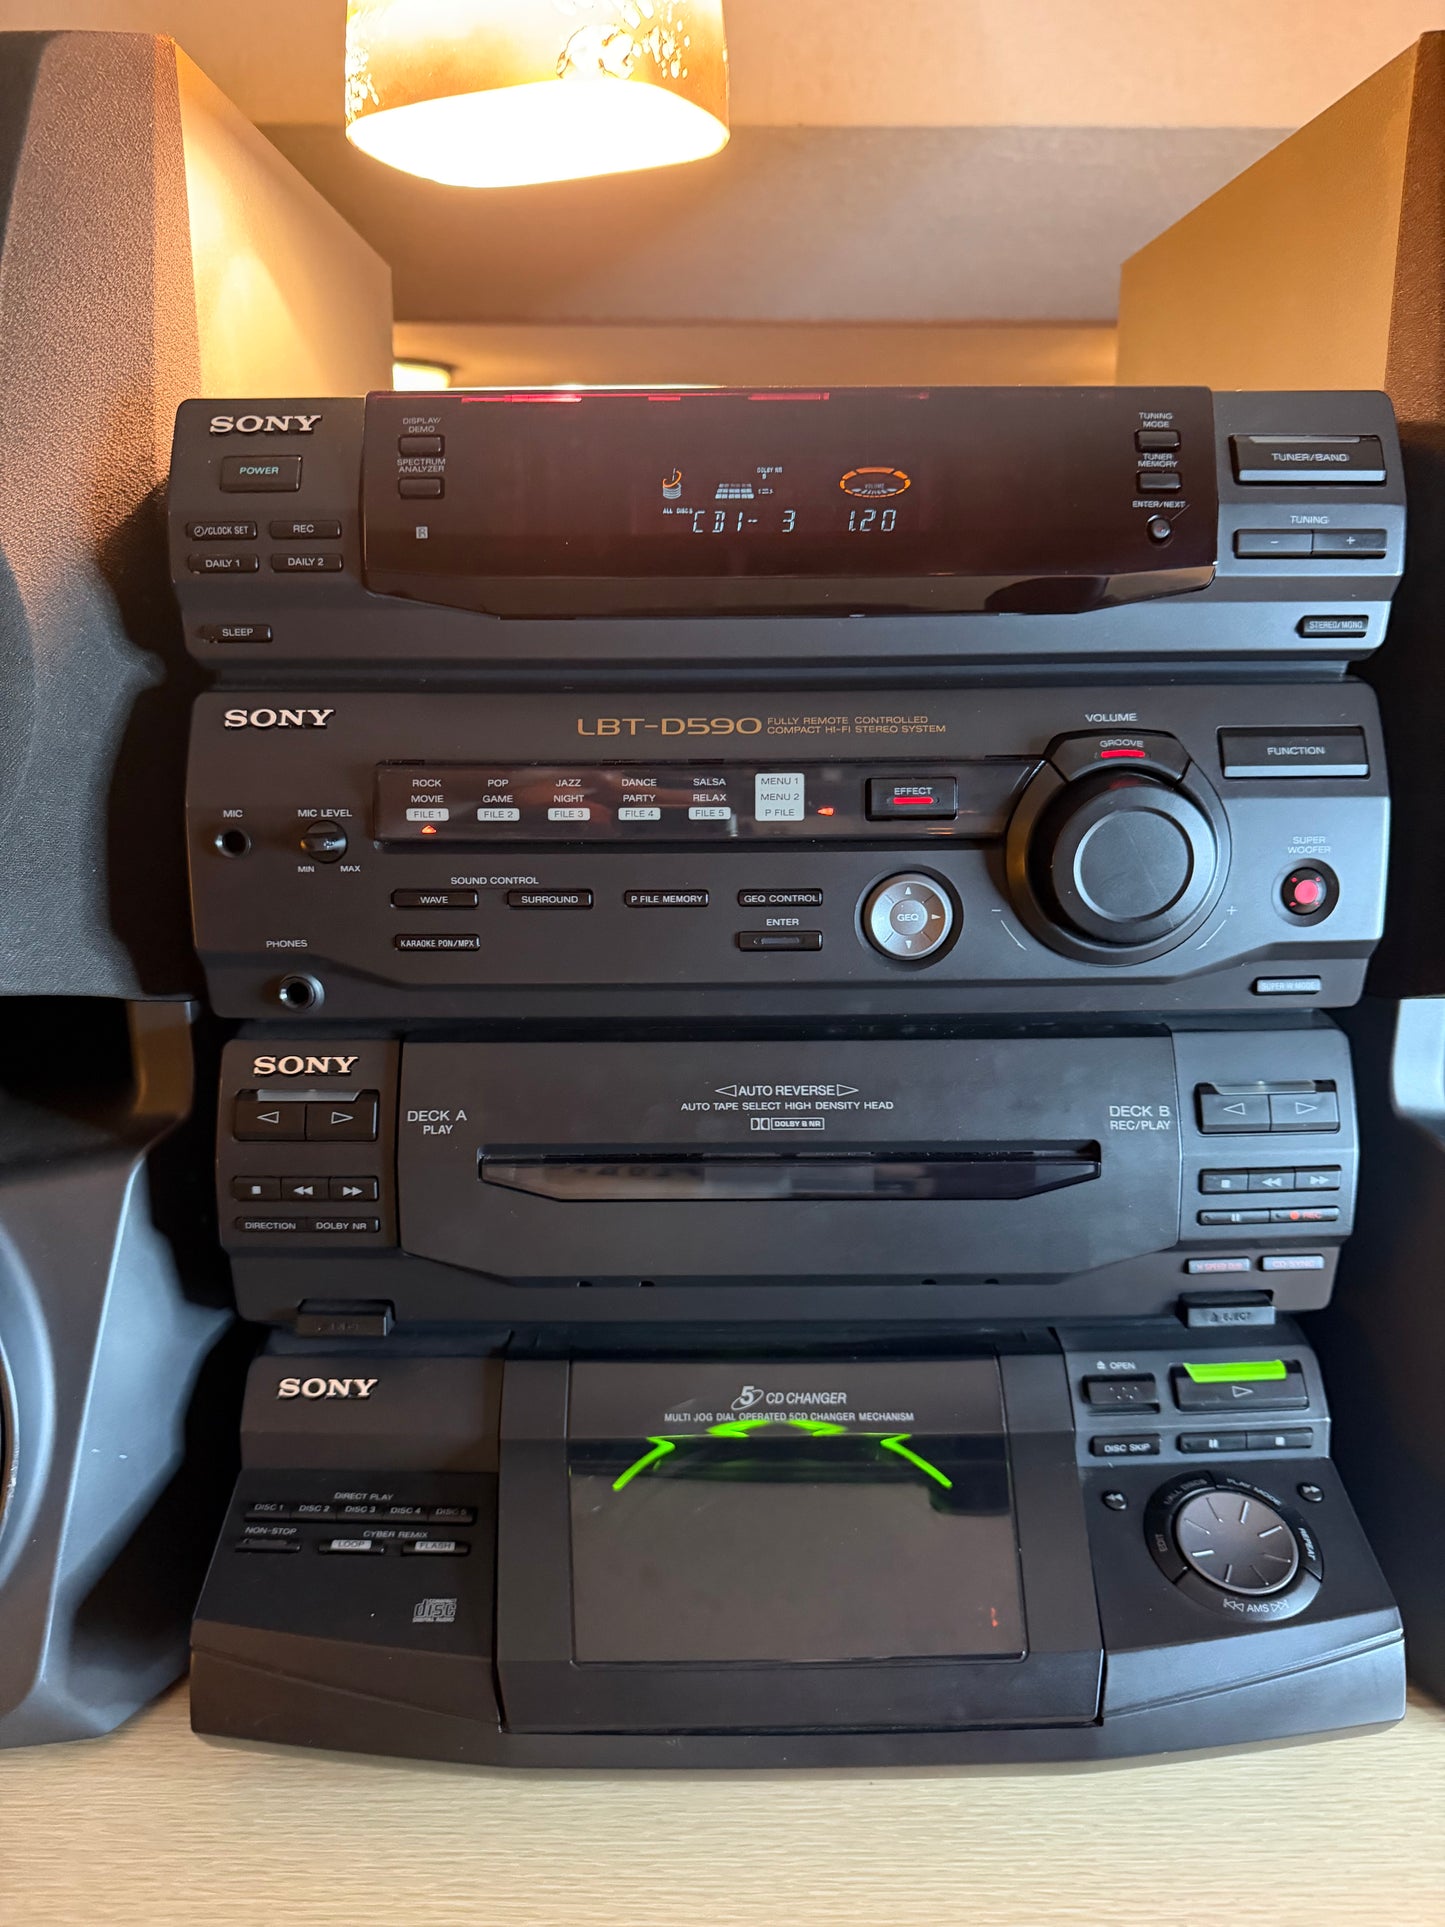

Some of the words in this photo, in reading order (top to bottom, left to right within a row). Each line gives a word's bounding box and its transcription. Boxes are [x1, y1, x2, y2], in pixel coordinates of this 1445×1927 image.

[1139, 412, 1173, 420] TUNING
[209, 415, 322, 433] SONY
[397, 458, 446, 466] SPECTRUM
[1272, 453, 1349, 462] TUNER/BAND
[240, 467, 279, 475] POWER
[1290, 516, 1330, 524] TUNING
[234, 525, 249, 535] SET
[293, 524, 314, 533] REC
[205, 559, 233, 568] DAILY
[236, 559, 240, 567] 1
[288, 558, 315, 566] DAILY
[318, 557, 324, 566] 2
[222, 628, 253, 637] SLEEP
[224, 709, 334, 727] SONY
[767, 717, 799, 725] FULLY
[803, 717, 849, 725] REMOTE
[854, 715, 928, 724] CONTROLLED
[1085, 713, 1138, 722] VOLUME
[577, 717, 762, 736] LBT-D590
[767, 726, 822, 734] COMPACT
[825, 725, 851, 734] HI-FI
[855, 725, 899, 733] STEREO
[901, 725, 946, 733] SYSTEM
[1099, 739, 1144, 748] GROOVE
[1267, 746, 1326, 756] FUNCTION
[412, 779, 441, 787] ROCK
[487, 779, 509, 787] POP
[555, 779, 581, 787] JAZZ
[693, 777, 726, 786] SALSA
[760, 777, 793, 786] MENU
[894, 786, 933, 795] EFFECT
[411, 795, 444, 803] MOVIE
[482, 795, 513, 803] GAME
[553, 794, 584, 803] NIGHT
[623, 794, 656, 802] PARTY
[693, 793, 727, 801] RELAX
[760, 792, 792, 801] MENU
[794, 792, 800, 801] 2
[223, 810, 243, 818] MIC
[298, 809, 317, 817] MIC
[321, 809, 352, 817] LEVEL
[414, 811, 434, 819] FILE
[554, 810, 576, 818] FILE
[577, 810, 583, 818] 3
[625, 810, 645, 818] FILE
[647, 810, 654, 818] 4
[695, 809, 716, 817] FILE
[719, 808, 725, 817] 5
[764, 808, 771, 816] P
[773, 808, 795, 816] FILE
[1293, 836, 1326, 844] SUPER
[1288, 846, 1331, 854] WOOFER
[451, 877, 487, 885] SOUND
[490, 876, 539, 884] CONTROL
[420, 896, 448, 904] WAVE
[521, 895, 578, 904] SURROUND
[631, 895, 638, 903] P
[640, 895, 660, 903] FILE
[662, 895, 703, 903] MEMORY
[744, 894, 766, 903] GEQ
[769, 894, 818, 903] CONTROL
[897, 912, 919, 922] GEQ
[766, 918, 799, 927] ENTER
[266, 939, 308, 948] PHONES
[400, 939, 436, 947] KARAOKE
[438, 939, 475, 947] PON/MPX
[253, 1056, 359, 1074] SONY
[738, 1086, 773, 1096] AUTO
[776, 1085, 835, 1096] REVERSE
[681, 1102, 710, 1111] AUTO
[713, 1102, 738, 1110] TAPE
[742, 1102, 781, 1110] SELECT
[785, 1102, 811, 1110] HIGH
[816, 1102, 859, 1110] DENSITY
[1109, 1106, 1152, 1117] DECK
[1159, 1105, 1170, 1116] B
[407, 1110, 450, 1122] DECK
[456, 1110, 467, 1121] A
[423, 1125, 453, 1135] PLAY
[1110, 1121, 1171, 1131] REC/PLAY
[245, 1222, 296, 1230] DIRECTION
[316, 1222, 349, 1230] DOLBY
[352, 1222, 366, 1230] NR
[278, 1378, 378, 1396] SONY
[739, 1386, 755, 1405] 5
[766, 1393, 784, 1404] CD
[786, 1392, 846, 1404] CHANGER
[664, 1413, 691, 1422] MULTI
[694, 1413, 713, 1422] JOG
[716, 1413, 736, 1421] DIAL
[739, 1412, 786, 1421] OPERATED
[810, 1412, 855, 1421] CHANGER
[859, 1412, 914, 1421] MECHANISM
[1104, 1444, 1127, 1452] DISC
[1129, 1443, 1150, 1451] SKIP
[245, 1527, 297, 1535] NON-STOP
[415, 1600, 456, 1617] disc
[1247, 1603, 1270, 1612] AMS
